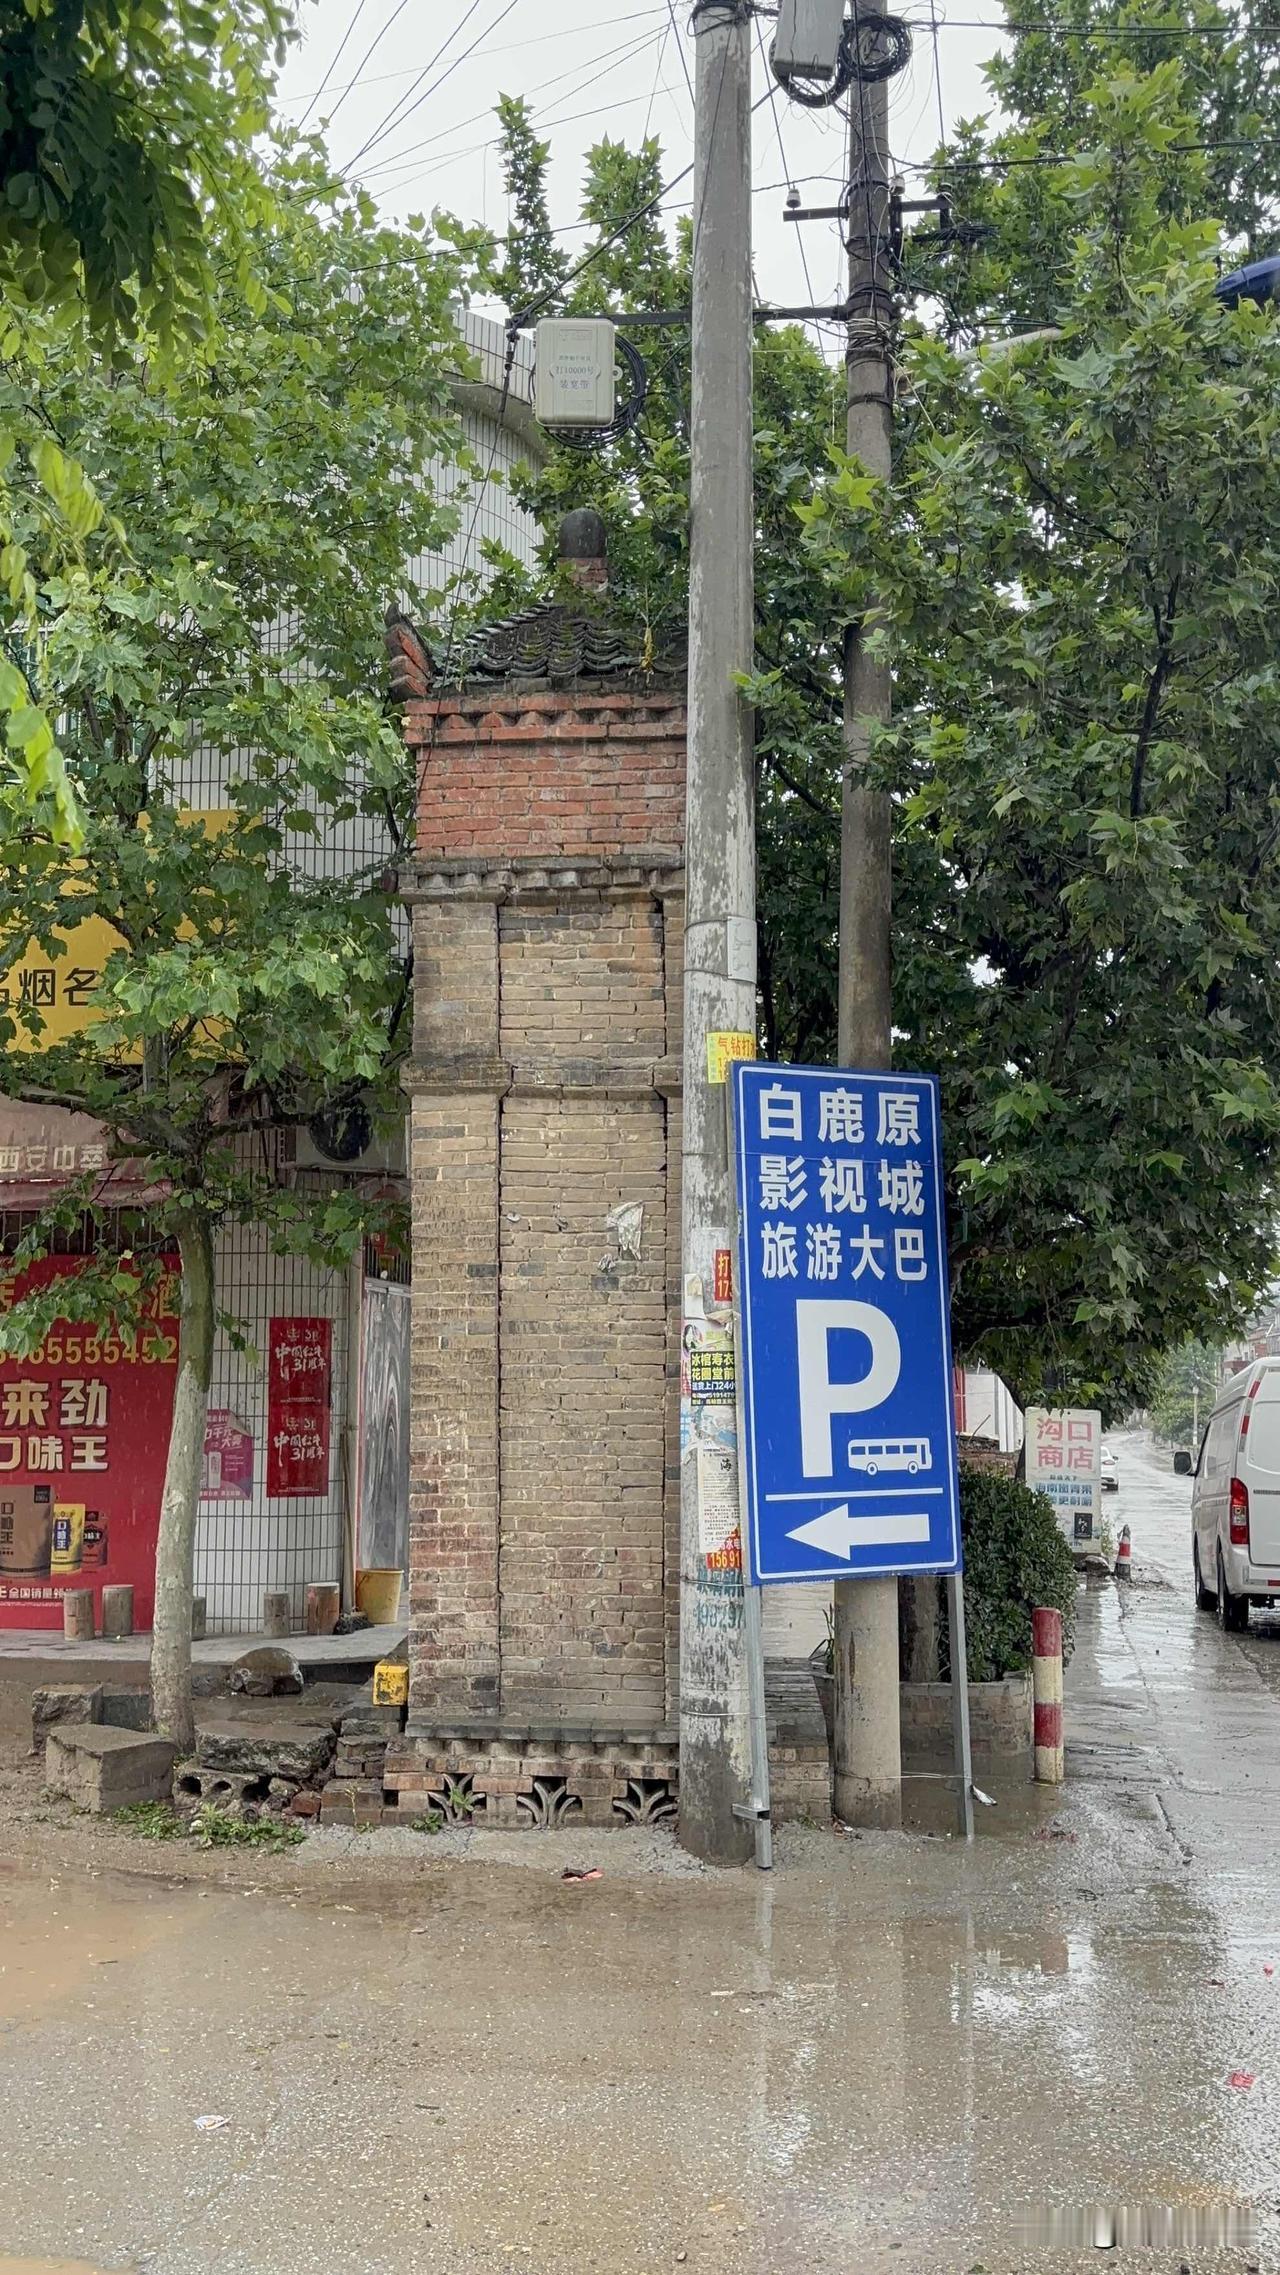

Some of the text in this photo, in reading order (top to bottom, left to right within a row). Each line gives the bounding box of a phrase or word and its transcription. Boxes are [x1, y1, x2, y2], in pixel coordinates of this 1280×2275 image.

[0, 967, 99, 1007] 烟名
[759, 1083, 922, 1146] 白鹿原
[759, 1155, 926, 1216] 影视城
[761, 1221, 928, 1281] 旅游大巴
[2, 1378, 108, 1427] 来劲
[796, 1299, 901, 1478] P
[1037, 1418, 1092, 1441] 沟口
[1037, 1445, 1093, 1469] 商店
